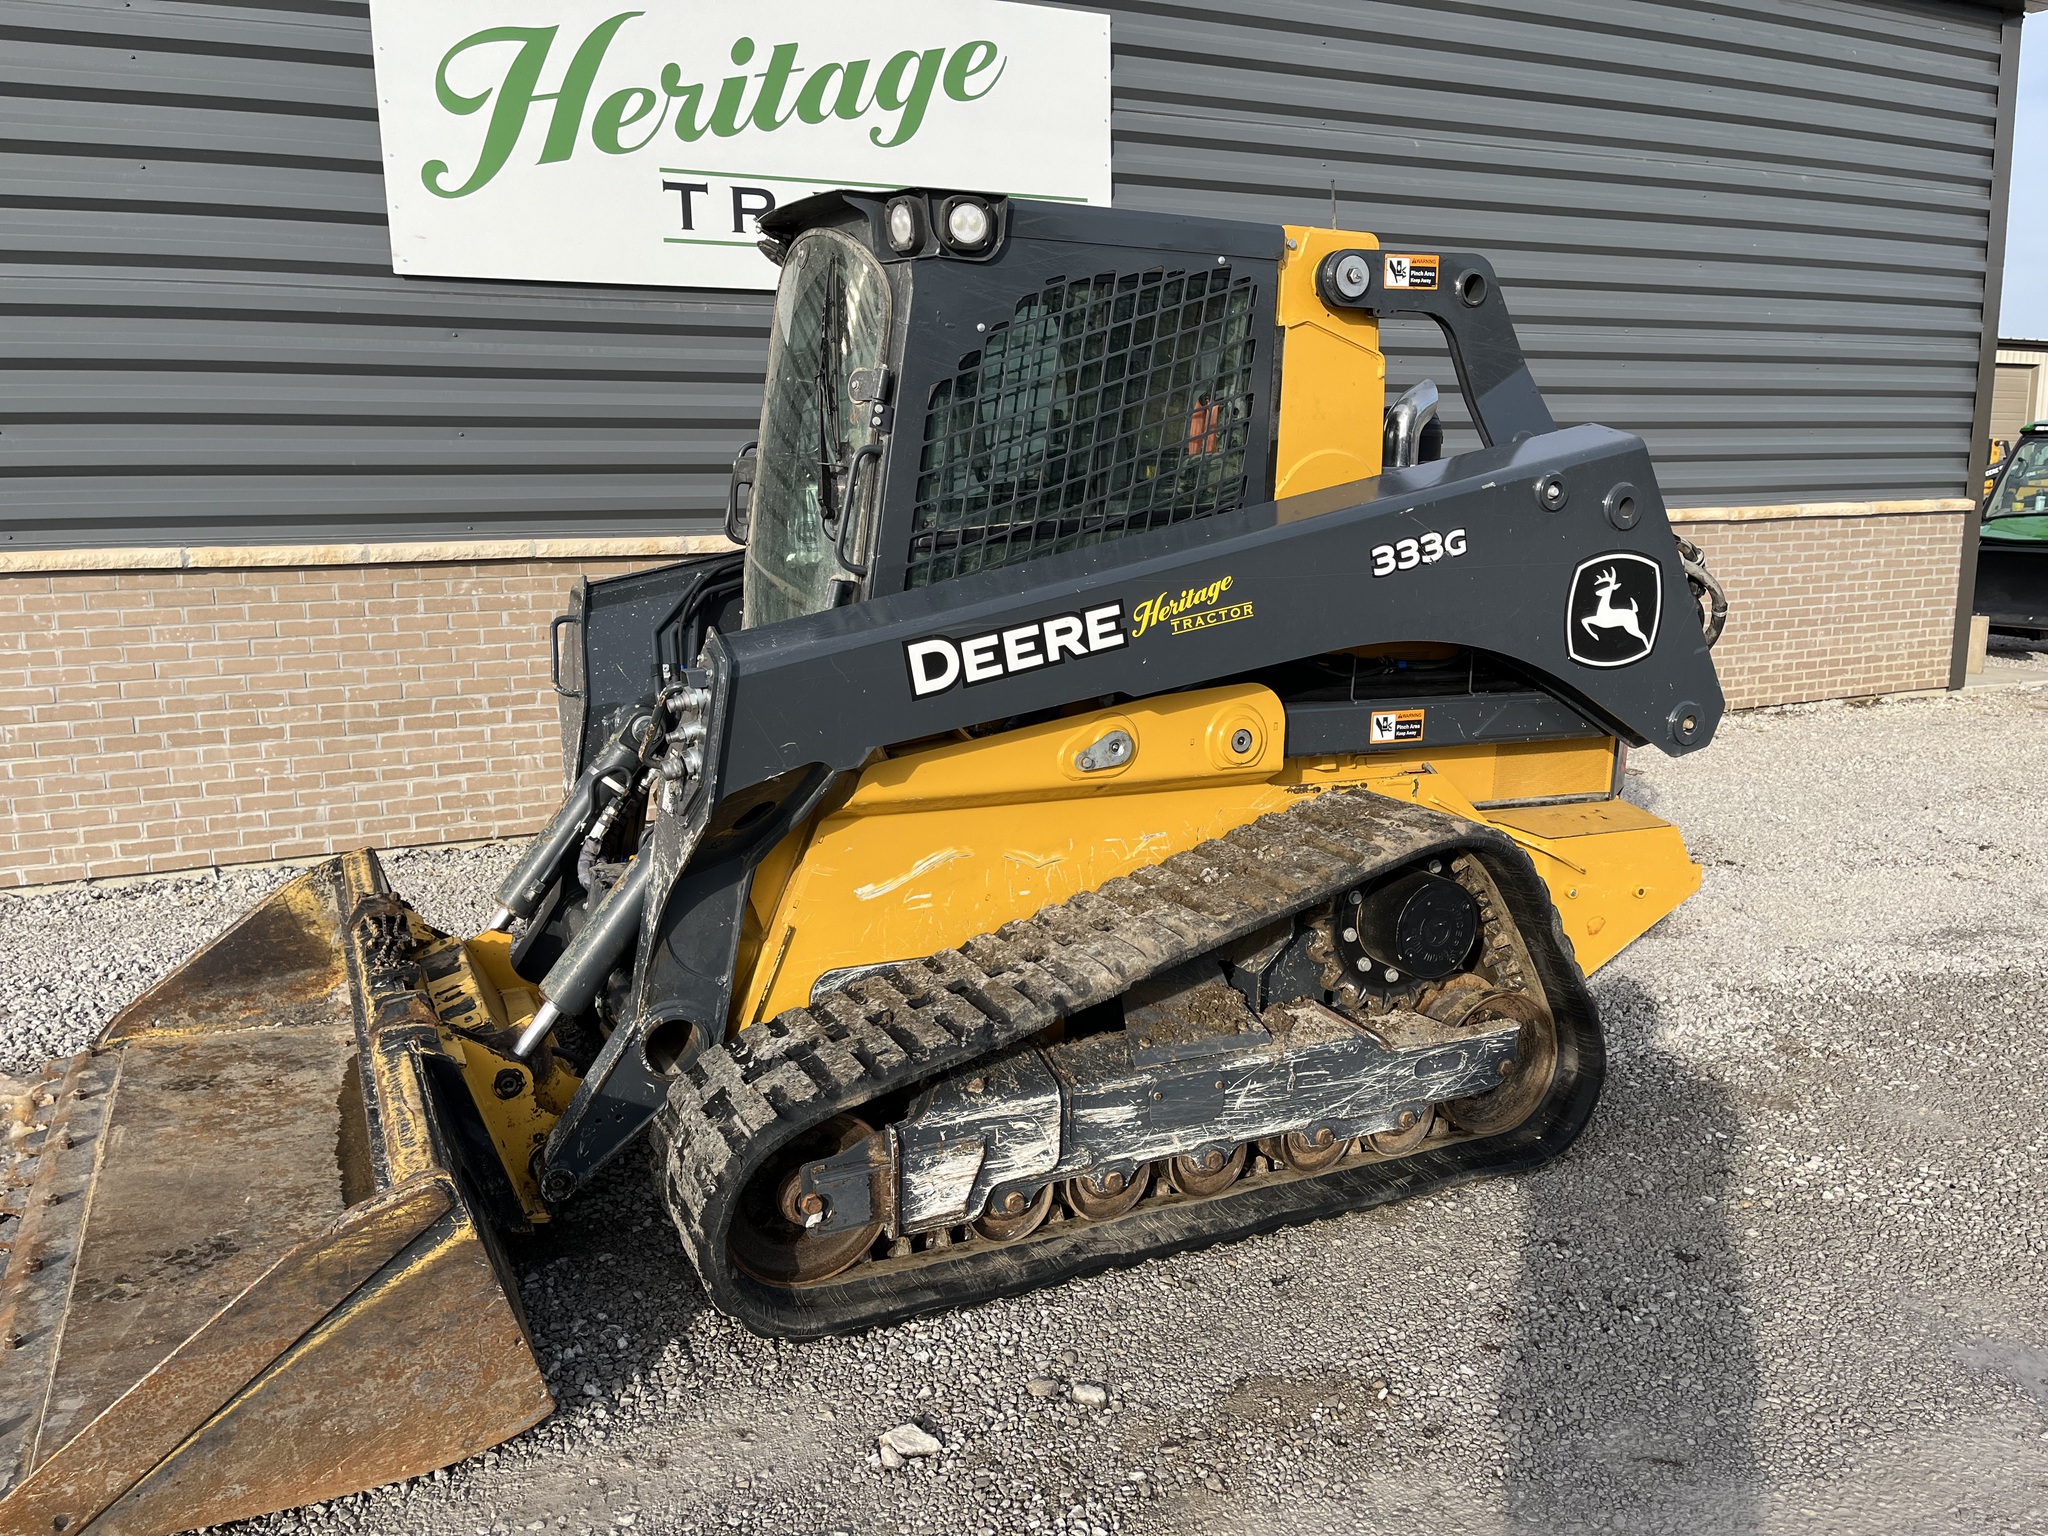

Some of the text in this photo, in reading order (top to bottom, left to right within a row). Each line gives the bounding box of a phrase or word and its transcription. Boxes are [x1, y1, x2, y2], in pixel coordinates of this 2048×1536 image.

[421, 11, 1007, 199] Heritage
[1371, 528, 1467, 577] 333G
[1131, 575, 1234, 638] Heritage
[1170, 604, 1254, 633] TRACTOR
[907, 603, 1126, 697] DEERE
